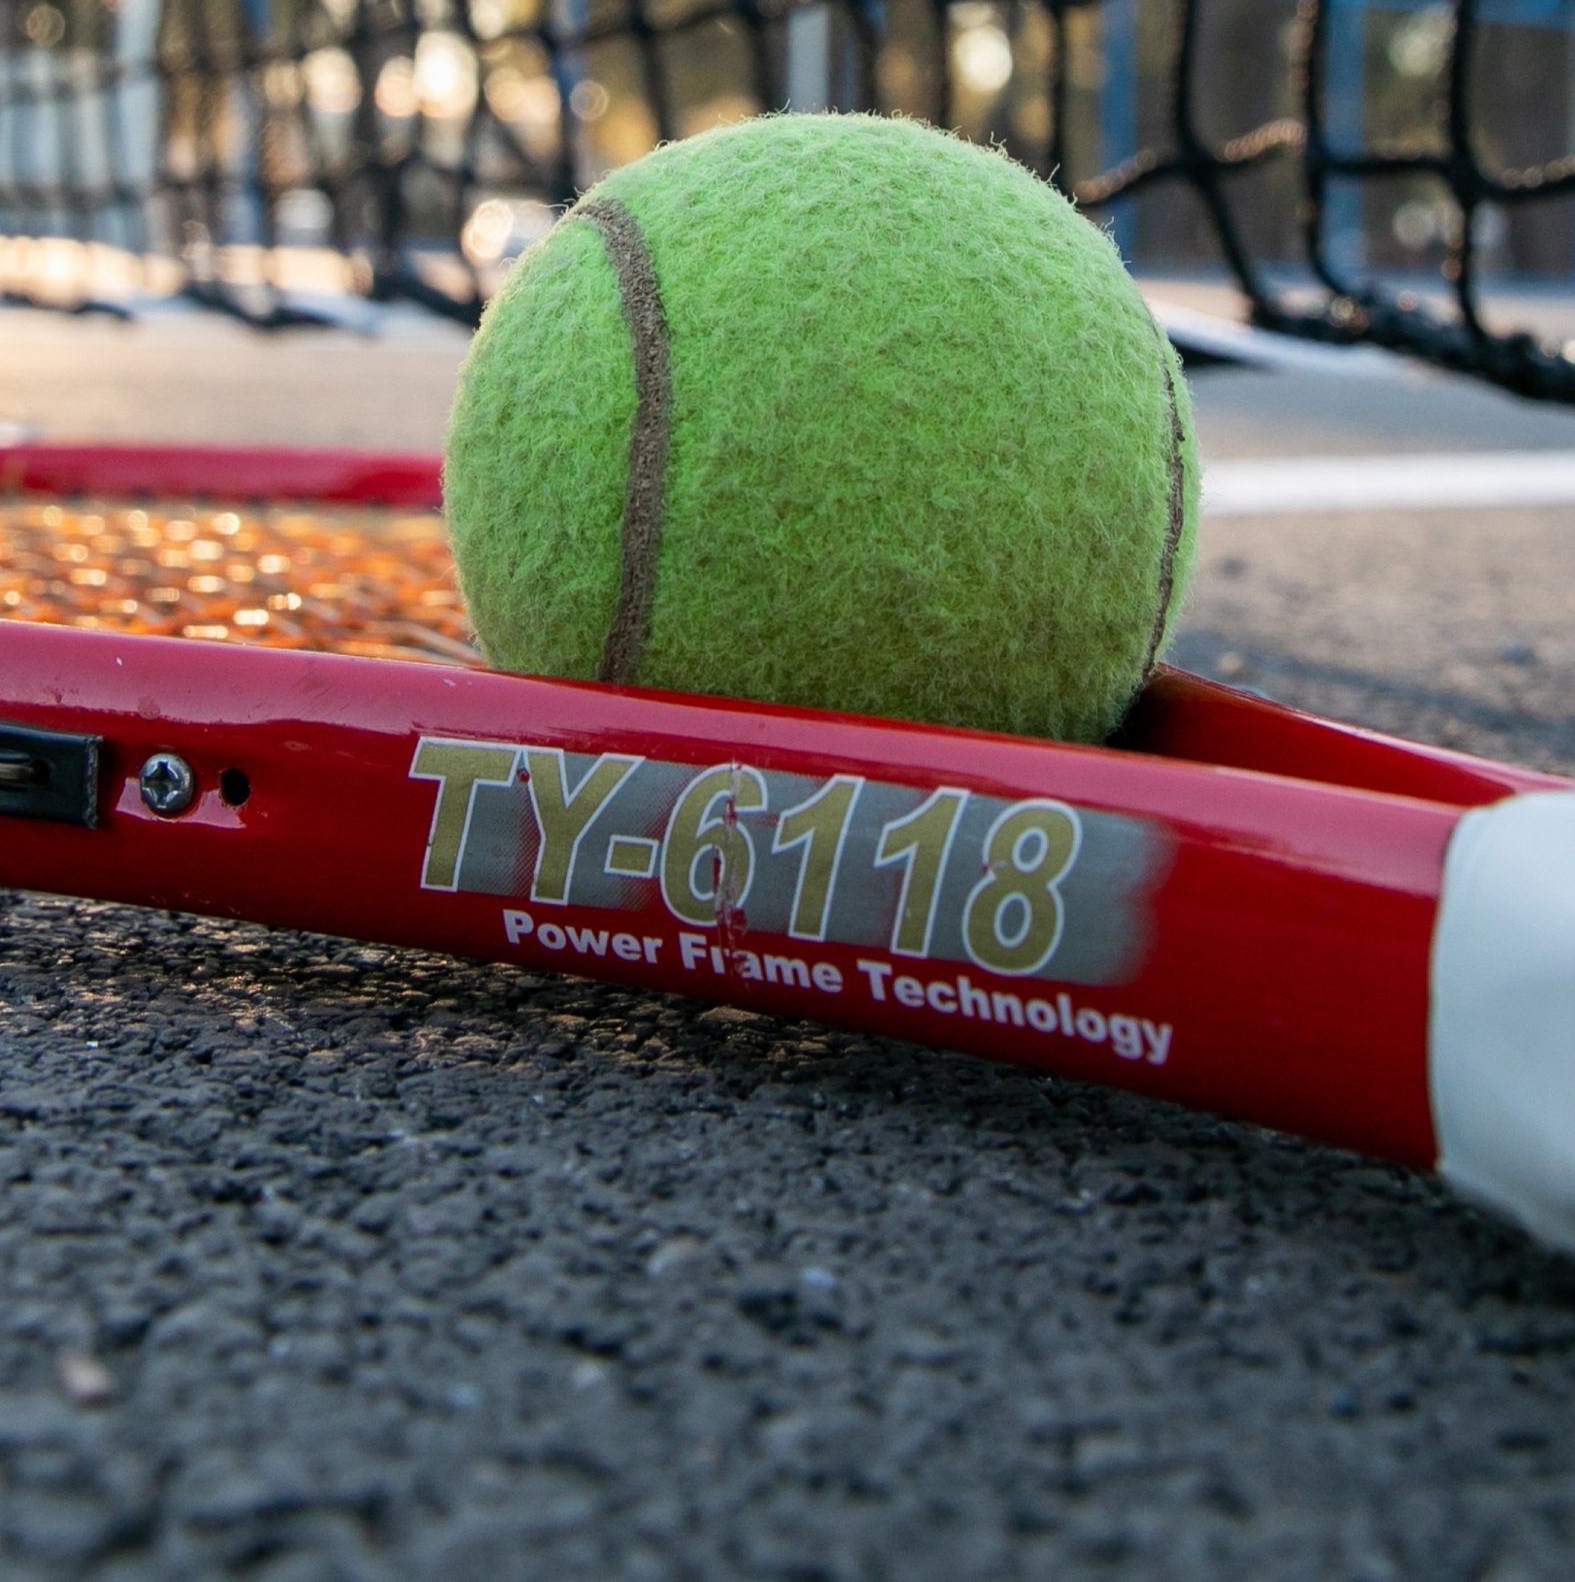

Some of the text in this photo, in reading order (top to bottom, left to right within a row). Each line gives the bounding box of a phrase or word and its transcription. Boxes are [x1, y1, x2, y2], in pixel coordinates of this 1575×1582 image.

[408, 736, 1083, 976] TY-6118
[503, 909, 1173, 1065] Power Frame Technology
